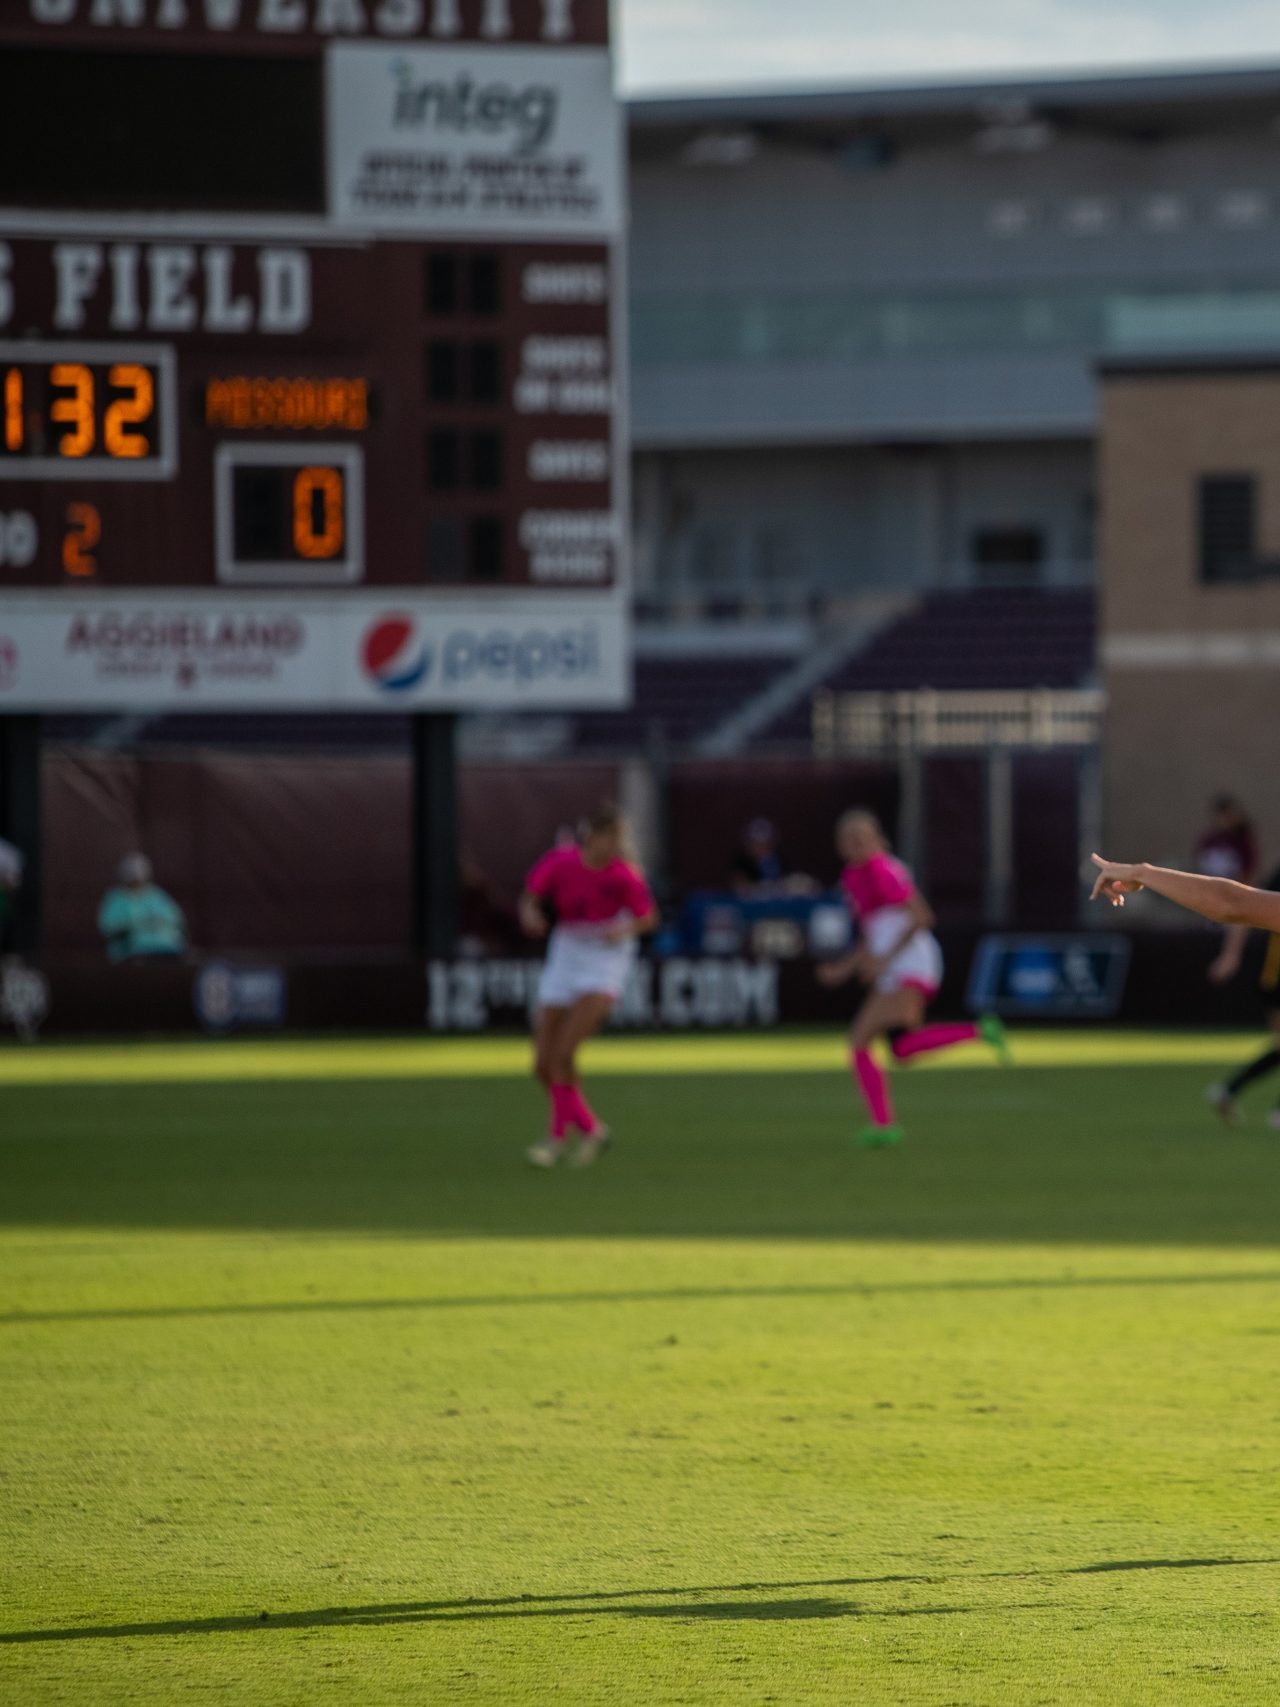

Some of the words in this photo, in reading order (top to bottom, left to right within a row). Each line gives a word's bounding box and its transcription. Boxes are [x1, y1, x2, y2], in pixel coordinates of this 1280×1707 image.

[53, 243, 312, 333] FIELD
[62, 502, 100, 577] 2
[293, 466, 343, 558] 0
[65, 612, 305, 655] AGGIELAND
[443, 622, 597, 684] pepsi
